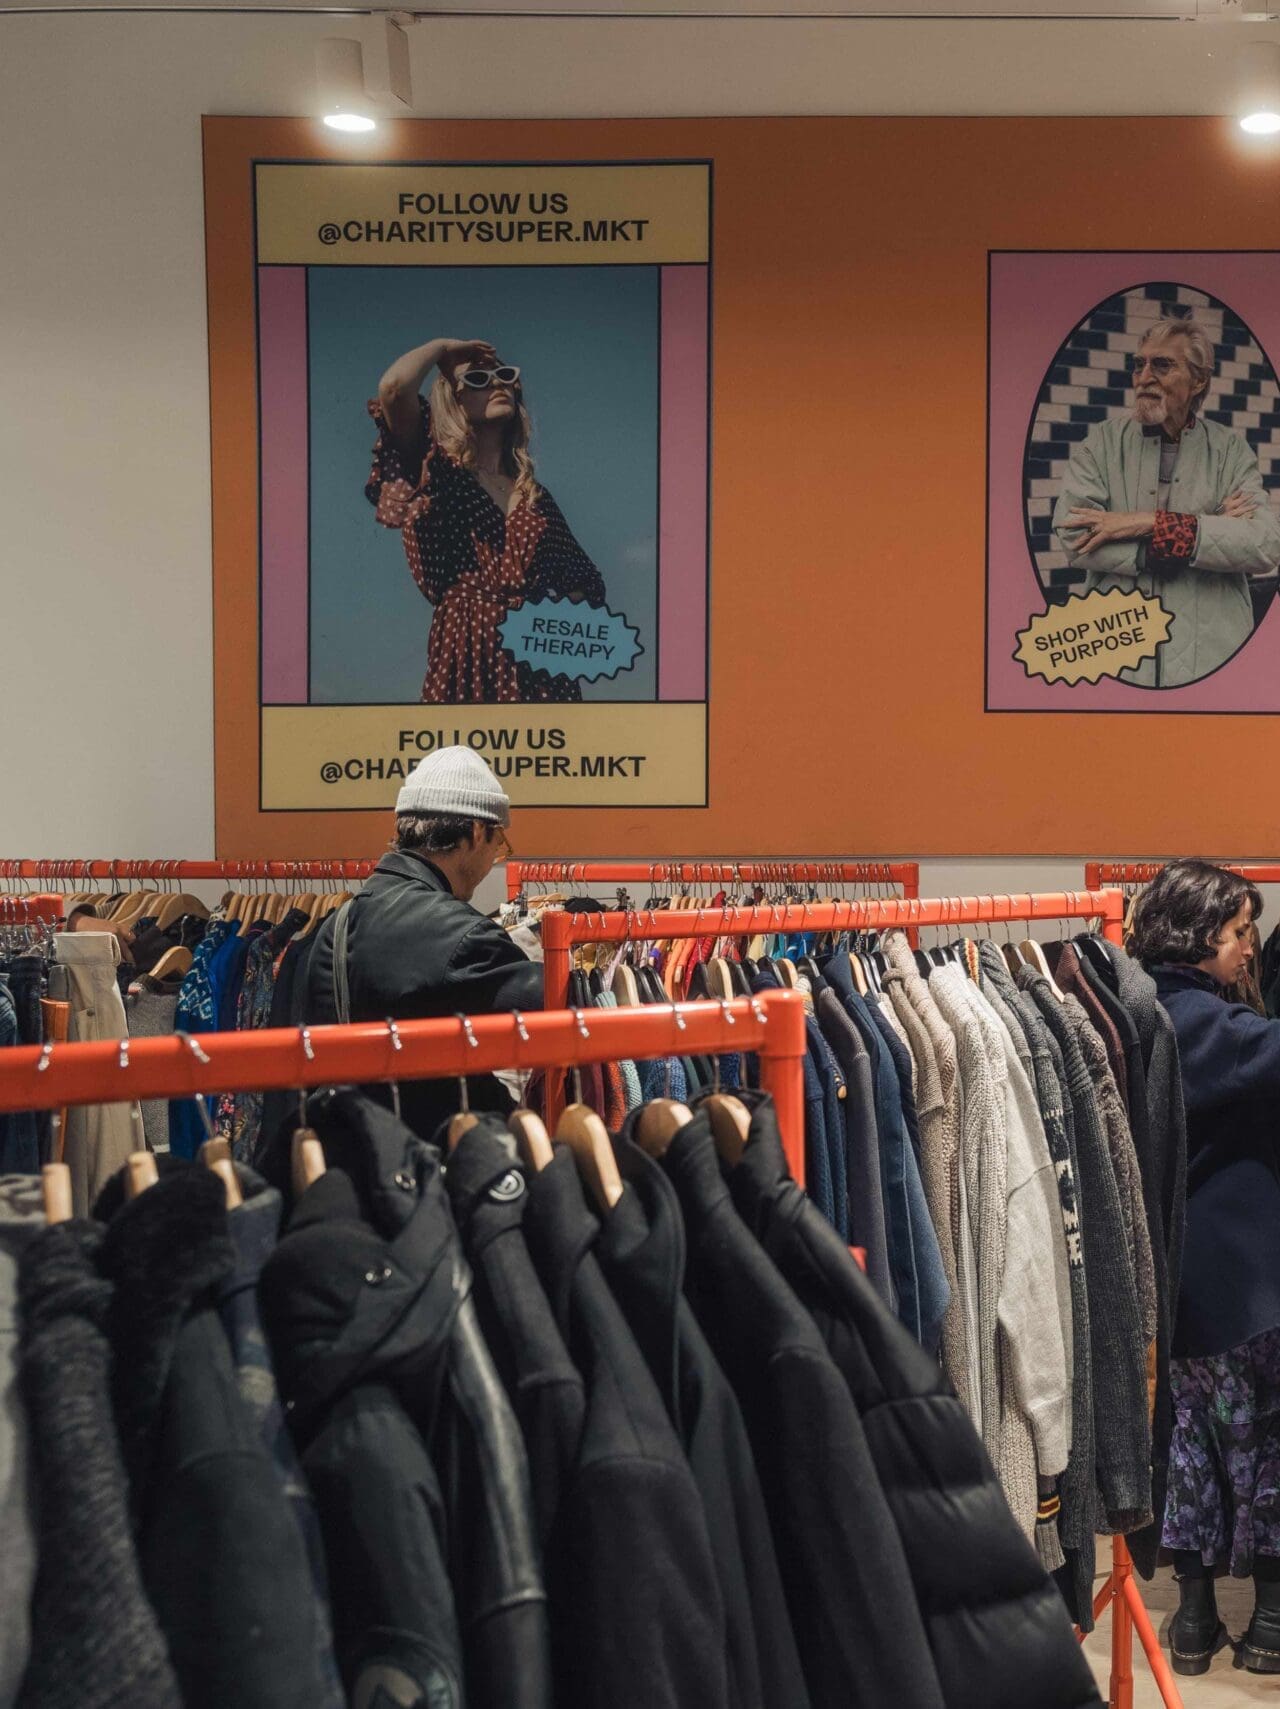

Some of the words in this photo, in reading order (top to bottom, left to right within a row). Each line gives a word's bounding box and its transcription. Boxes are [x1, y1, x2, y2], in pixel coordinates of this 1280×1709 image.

[398, 192, 521, 215] FOLLOW
[528, 192, 569, 214] US
[318, 219, 649, 245] @CHARITYSUPER.MKT
[531, 617, 609, 641] RESALE
[1034, 623, 1090, 651] SHOP
[1093, 605, 1149, 634] WITH
[520, 635, 616, 661] THERAPY
[1049, 626, 1147, 669] PURPOSE
[526, 728, 566, 750] US
